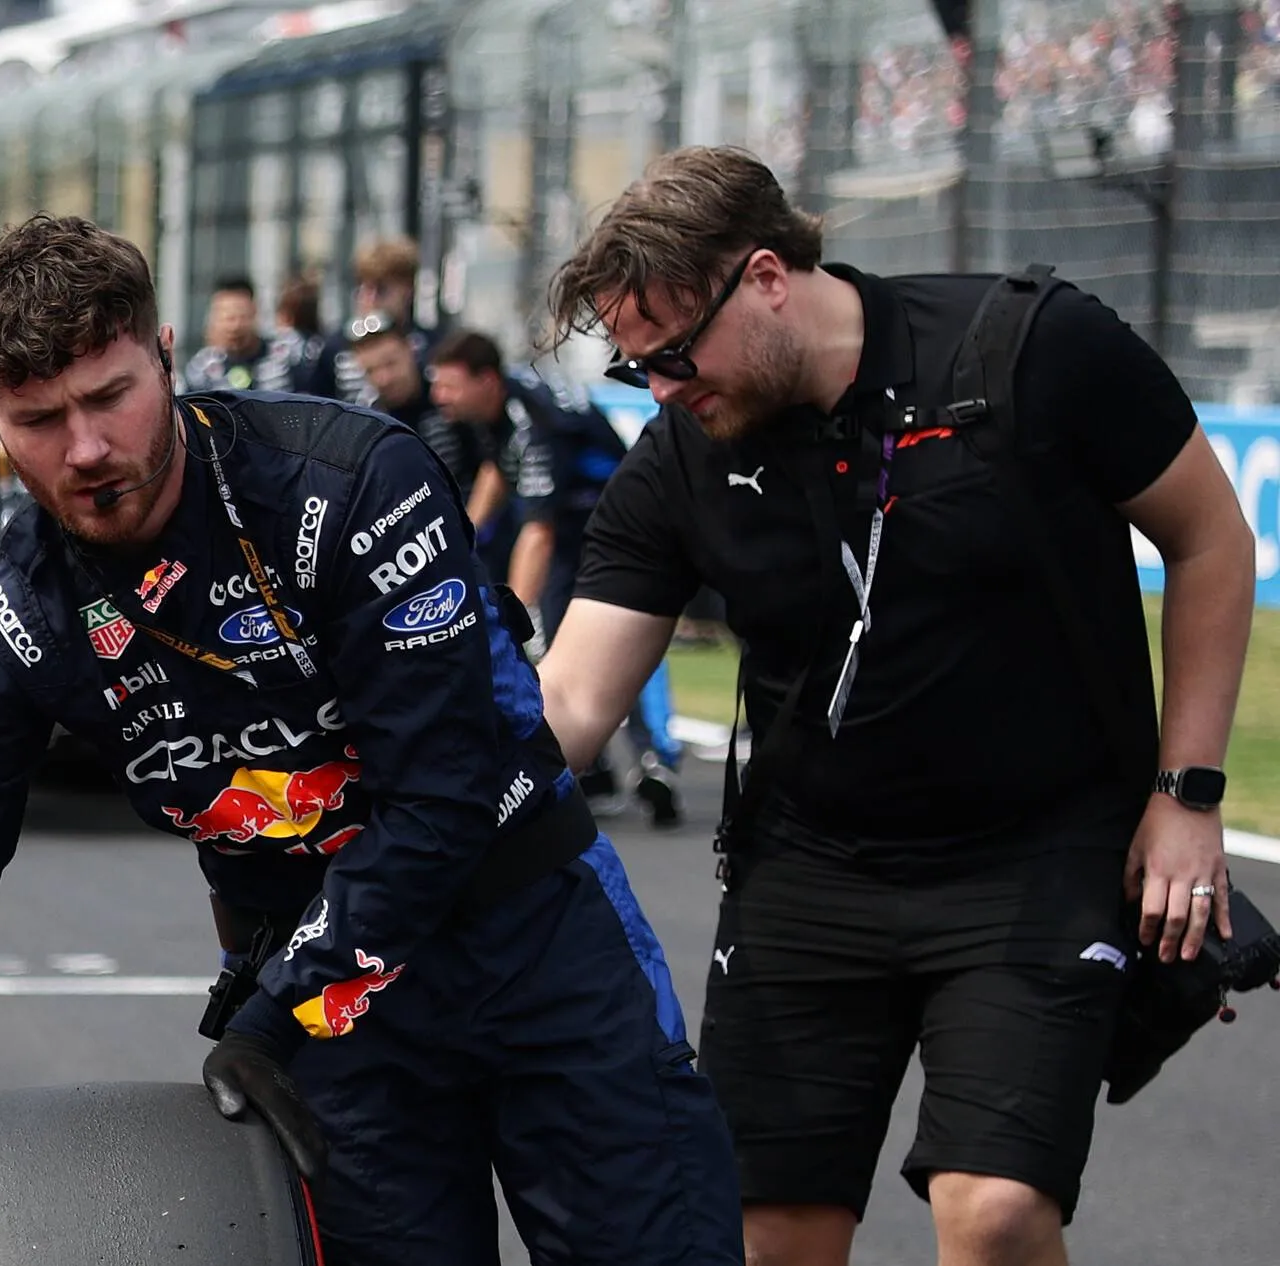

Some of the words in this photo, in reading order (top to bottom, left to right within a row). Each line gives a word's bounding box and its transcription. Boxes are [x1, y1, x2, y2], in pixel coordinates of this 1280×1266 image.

[371, 482, 432, 538] 1Password
[295, 496, 328, 589] sparco
[368, 516, 448, 596] ROKT
[87, 601, 122, 630] AG
[384, 611, 478, 652] RACING
[405, 589, 455, 627] Ford
[89, 617, 135, 656] EUER
[125, 697, 347, 784] ORACLE
